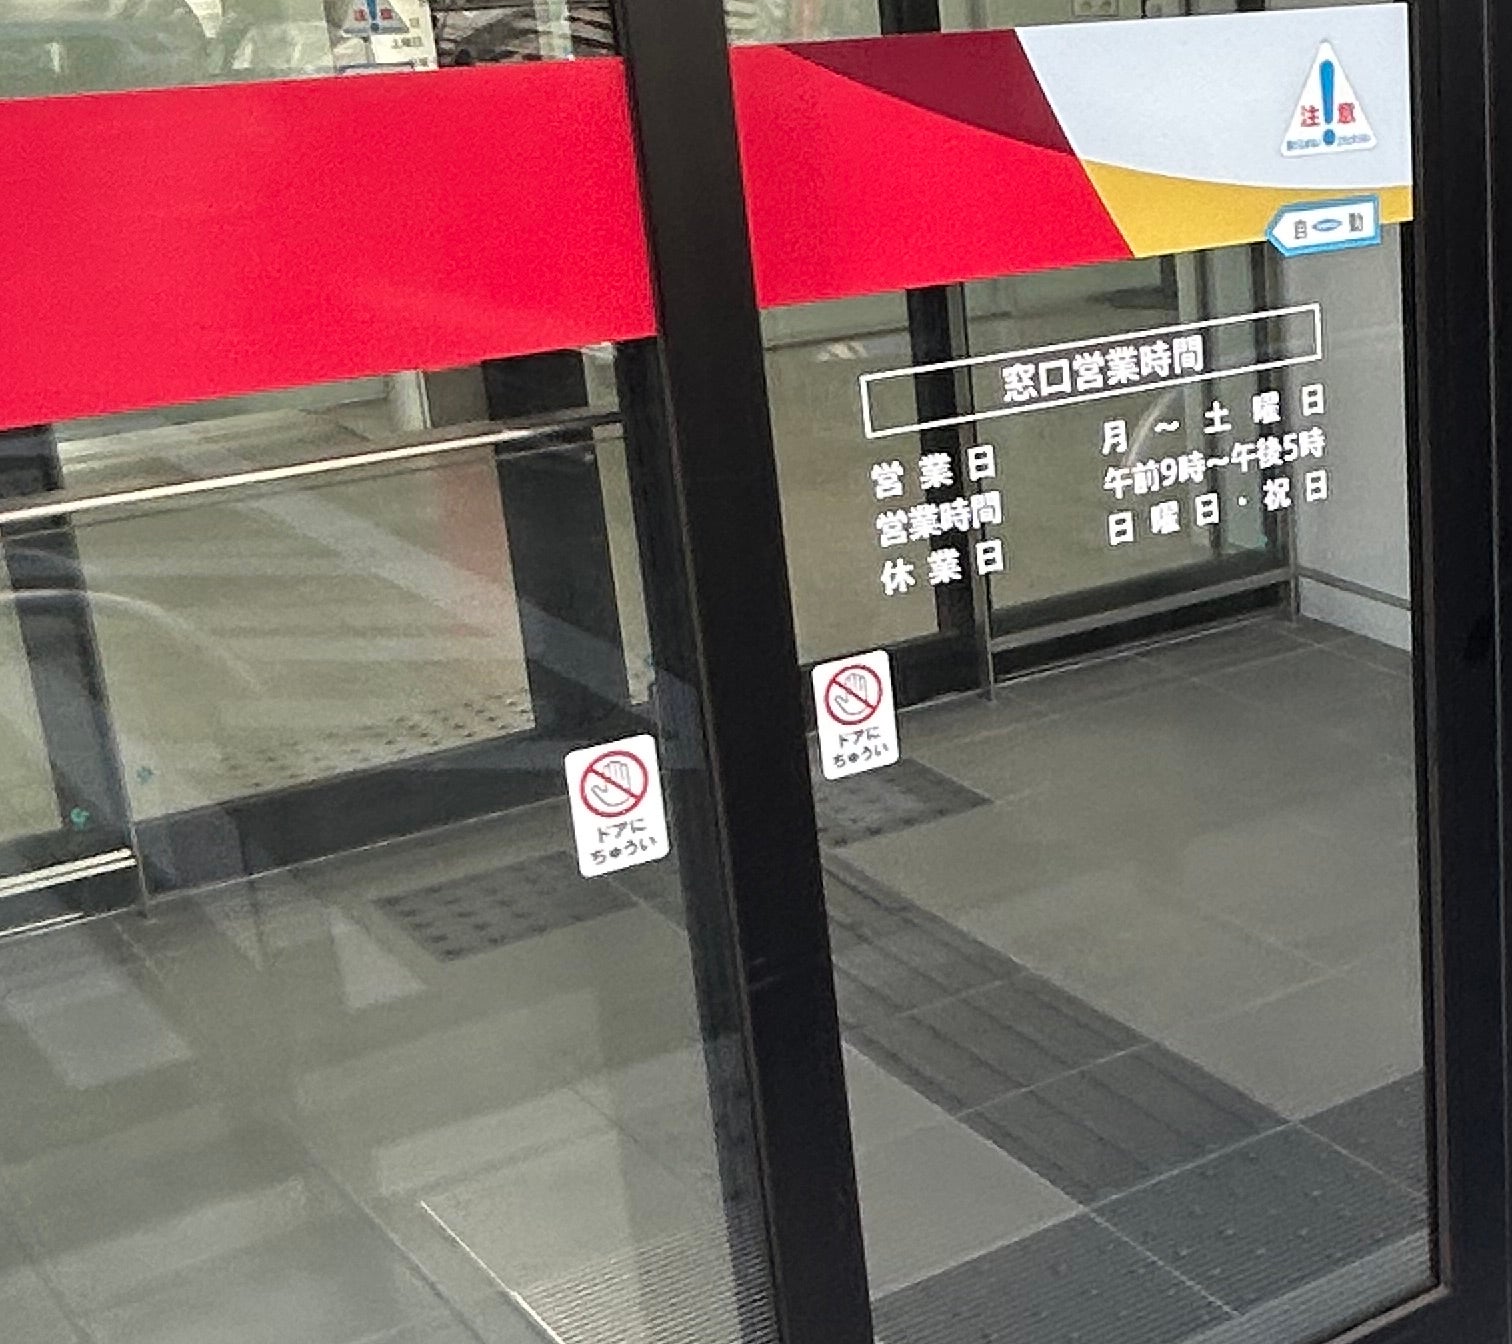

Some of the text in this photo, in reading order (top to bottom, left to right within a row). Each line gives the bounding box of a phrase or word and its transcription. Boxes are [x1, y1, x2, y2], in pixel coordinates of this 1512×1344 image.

[1002, 335, 1205, 404] 窓口営業時間
[870, 444, 998, 501] 営業日
[875, 490, 1004, 549] 営業時間
[880, 540, 1006, 597] 休業日
[832, 743, 890, 769] ちゅうい
[590, 836, 658, 866] ちゅうい
